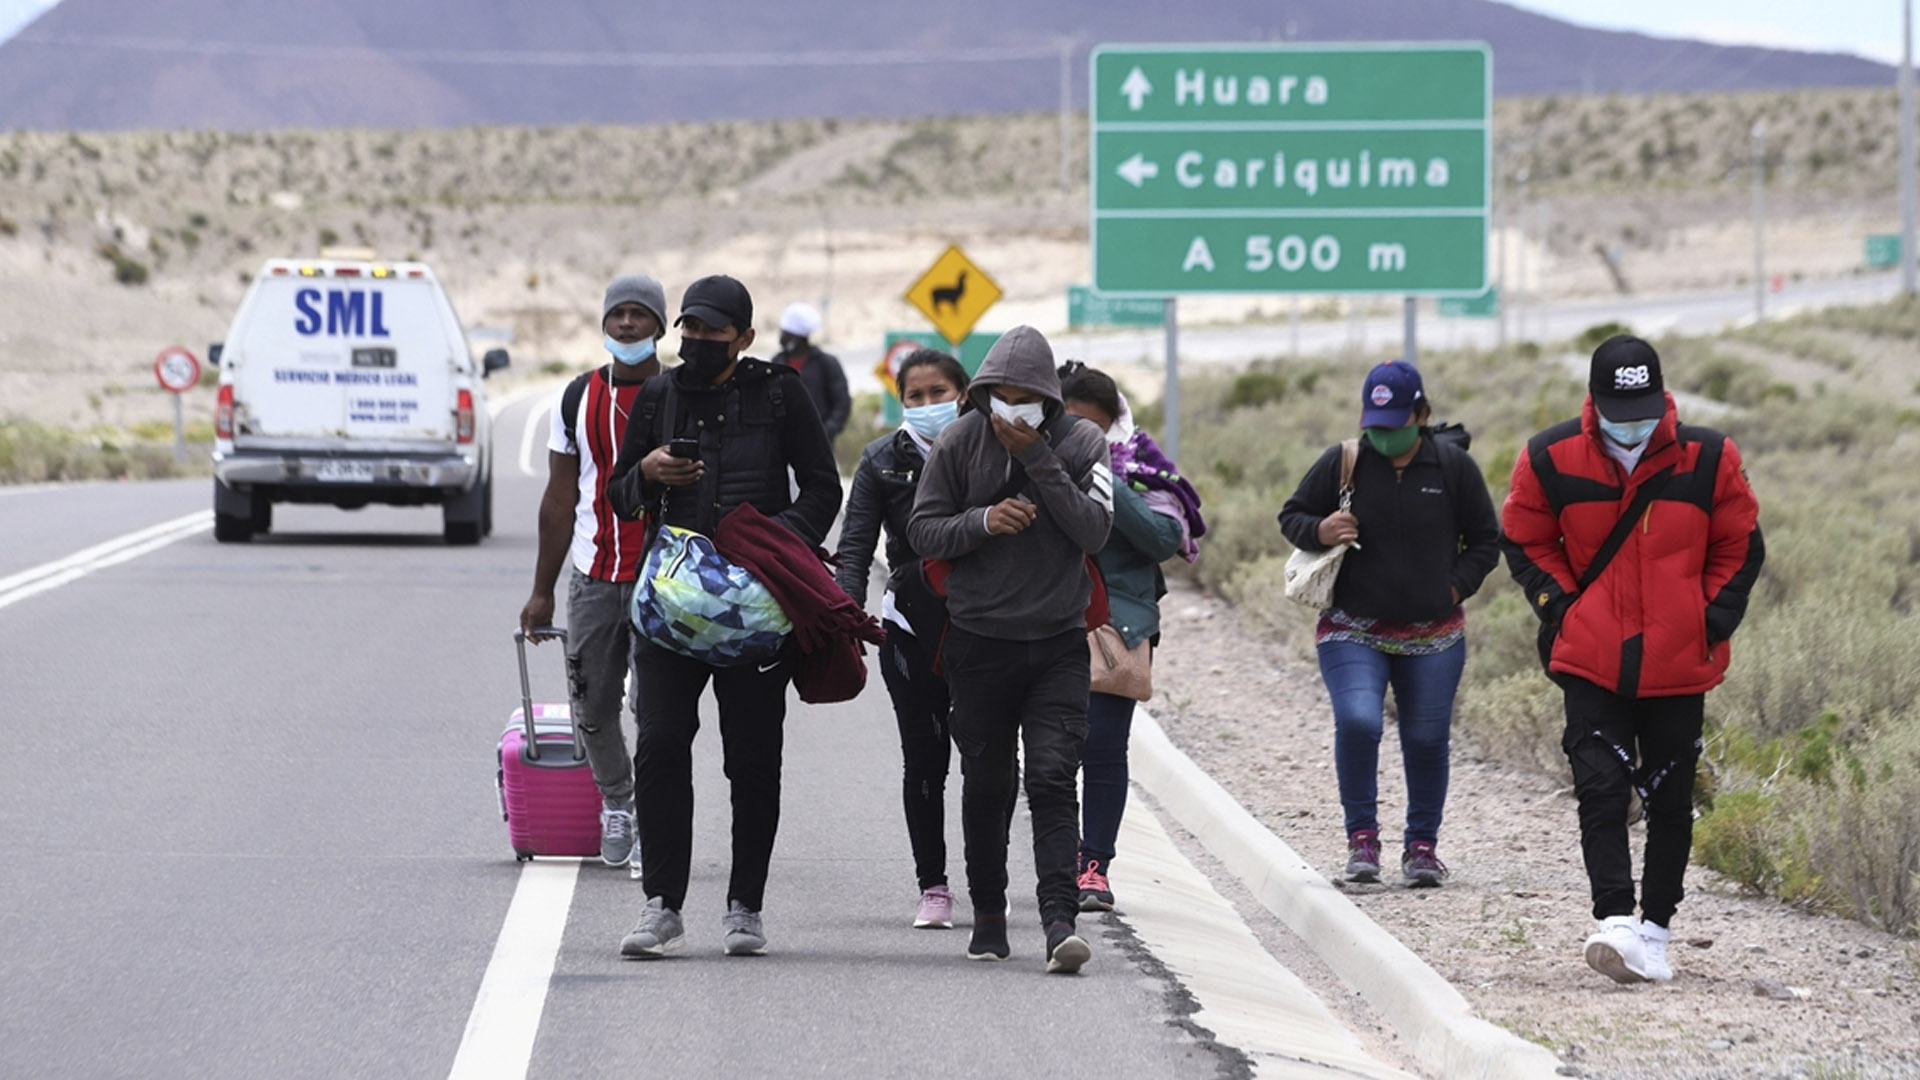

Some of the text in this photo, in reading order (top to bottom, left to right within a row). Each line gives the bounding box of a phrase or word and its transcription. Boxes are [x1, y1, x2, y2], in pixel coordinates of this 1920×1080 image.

[1175, 69, 1329, 105] Huara
[1175, 151, 1450, 196] Cariquima
[1183, 235, 1406, 272] A 500 m
[294, 288, 391, 338] SML
